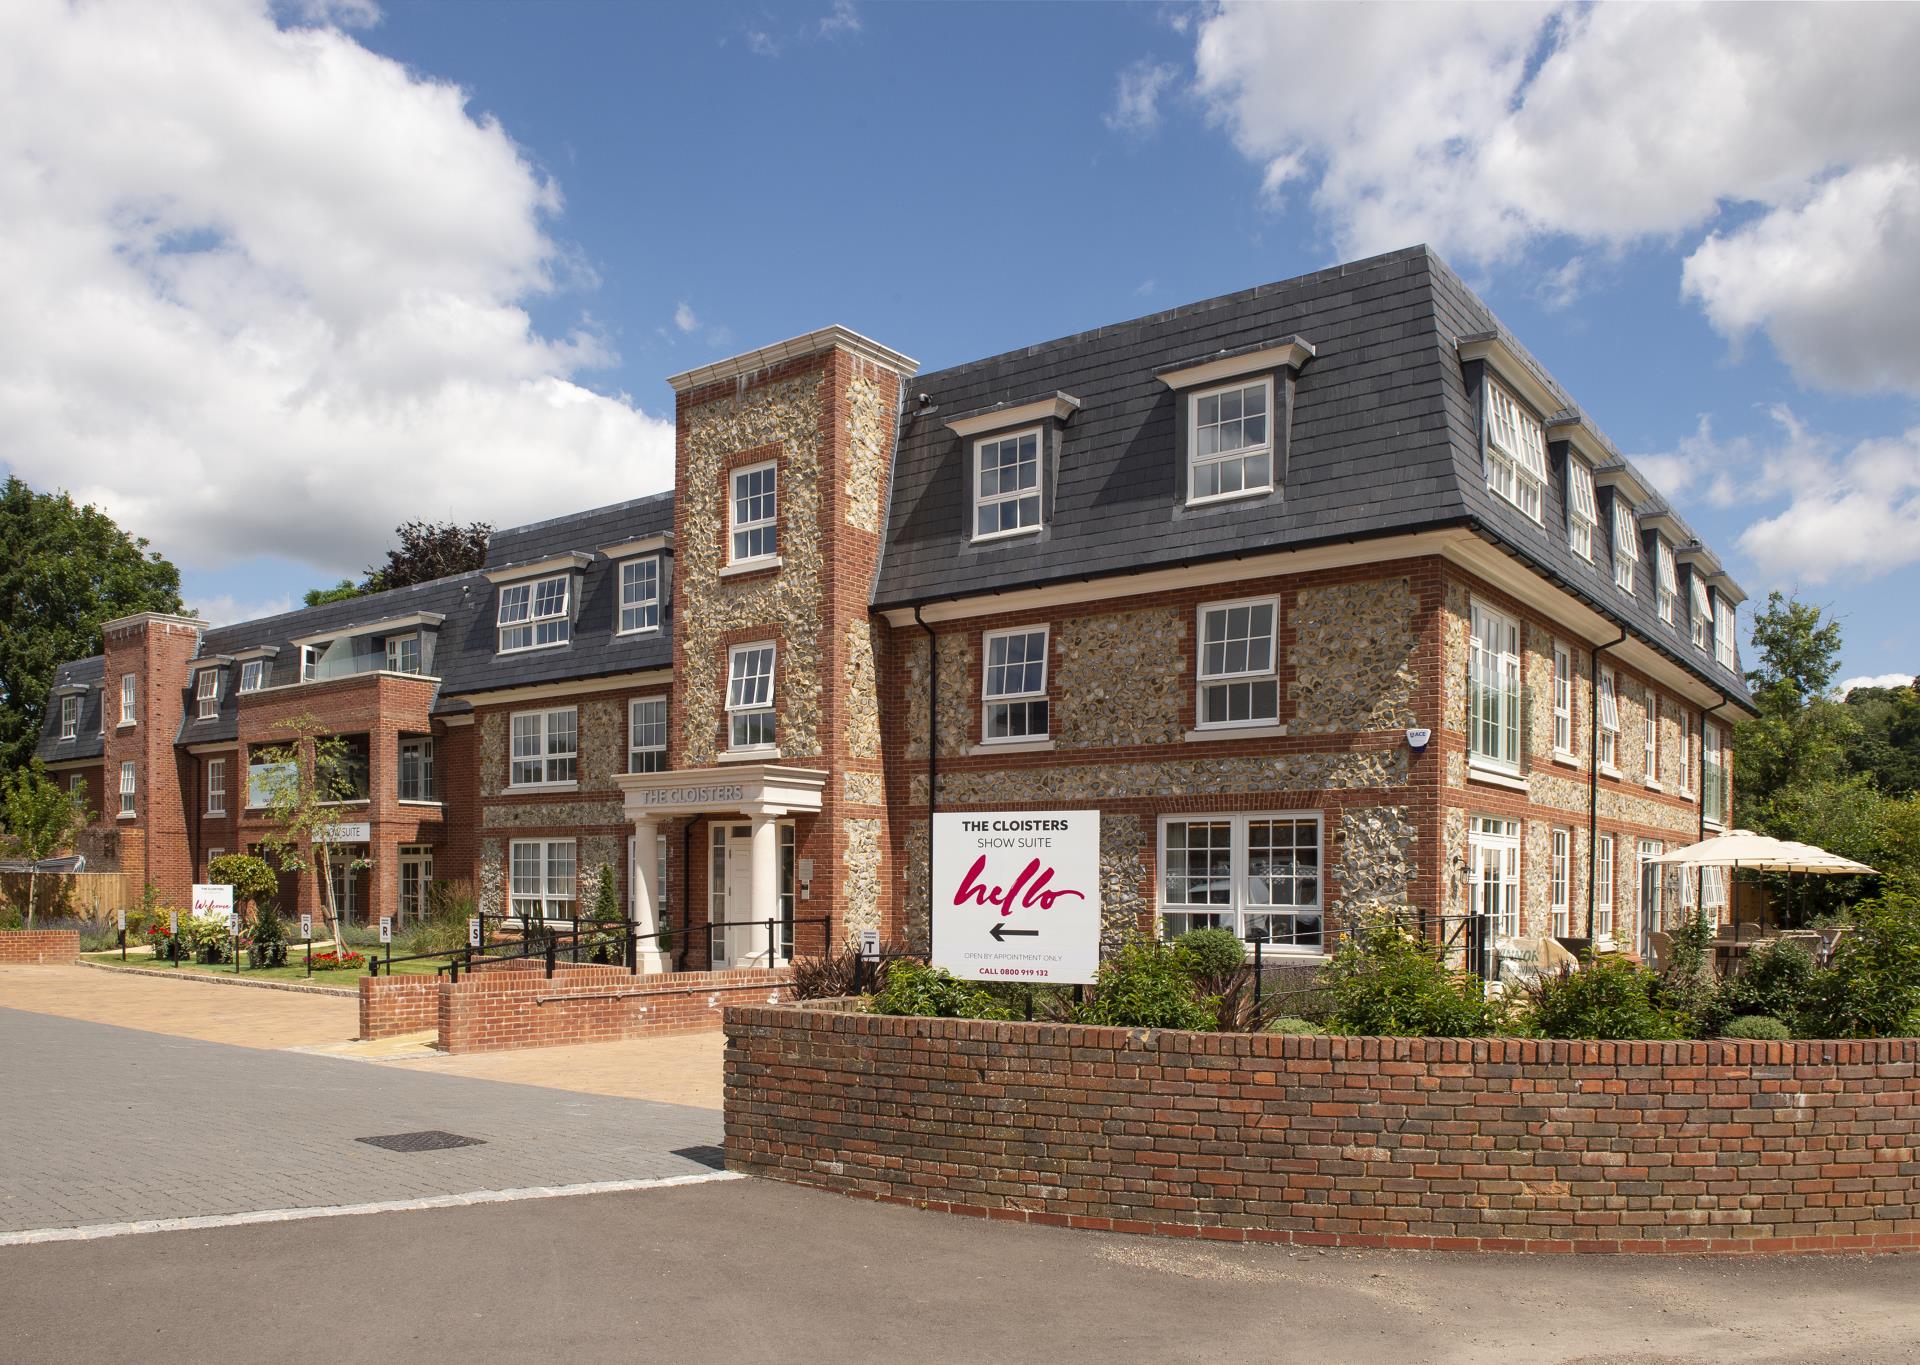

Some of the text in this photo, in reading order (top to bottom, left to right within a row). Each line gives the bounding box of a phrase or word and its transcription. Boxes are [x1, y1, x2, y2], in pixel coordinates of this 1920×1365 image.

[640, 785, 743, 804] THE CLOISTERS
[342, 826, 361, 837] SUITE
[962, 820, 1069, 832] THE CLOISTERS
[977, 838, 1052, 849] SHOW SUITE
[953, 854, 1085, 916] hello
[195, 899, 232, 910] Welcome
[303, 923, 309, 935] Q
[382, 926, 389, 936] R
[473, 928, 479, 940] S
[865, 941, 875, 954] T
[964, 952, 983, 960] OPEN
[994, 953, 1041, 961] APPOINTMENT
[979, 967, 999, 975] CALL
[1000, 968, 1019, 976] 0800
[1035, 969, 1048, 977] 132
